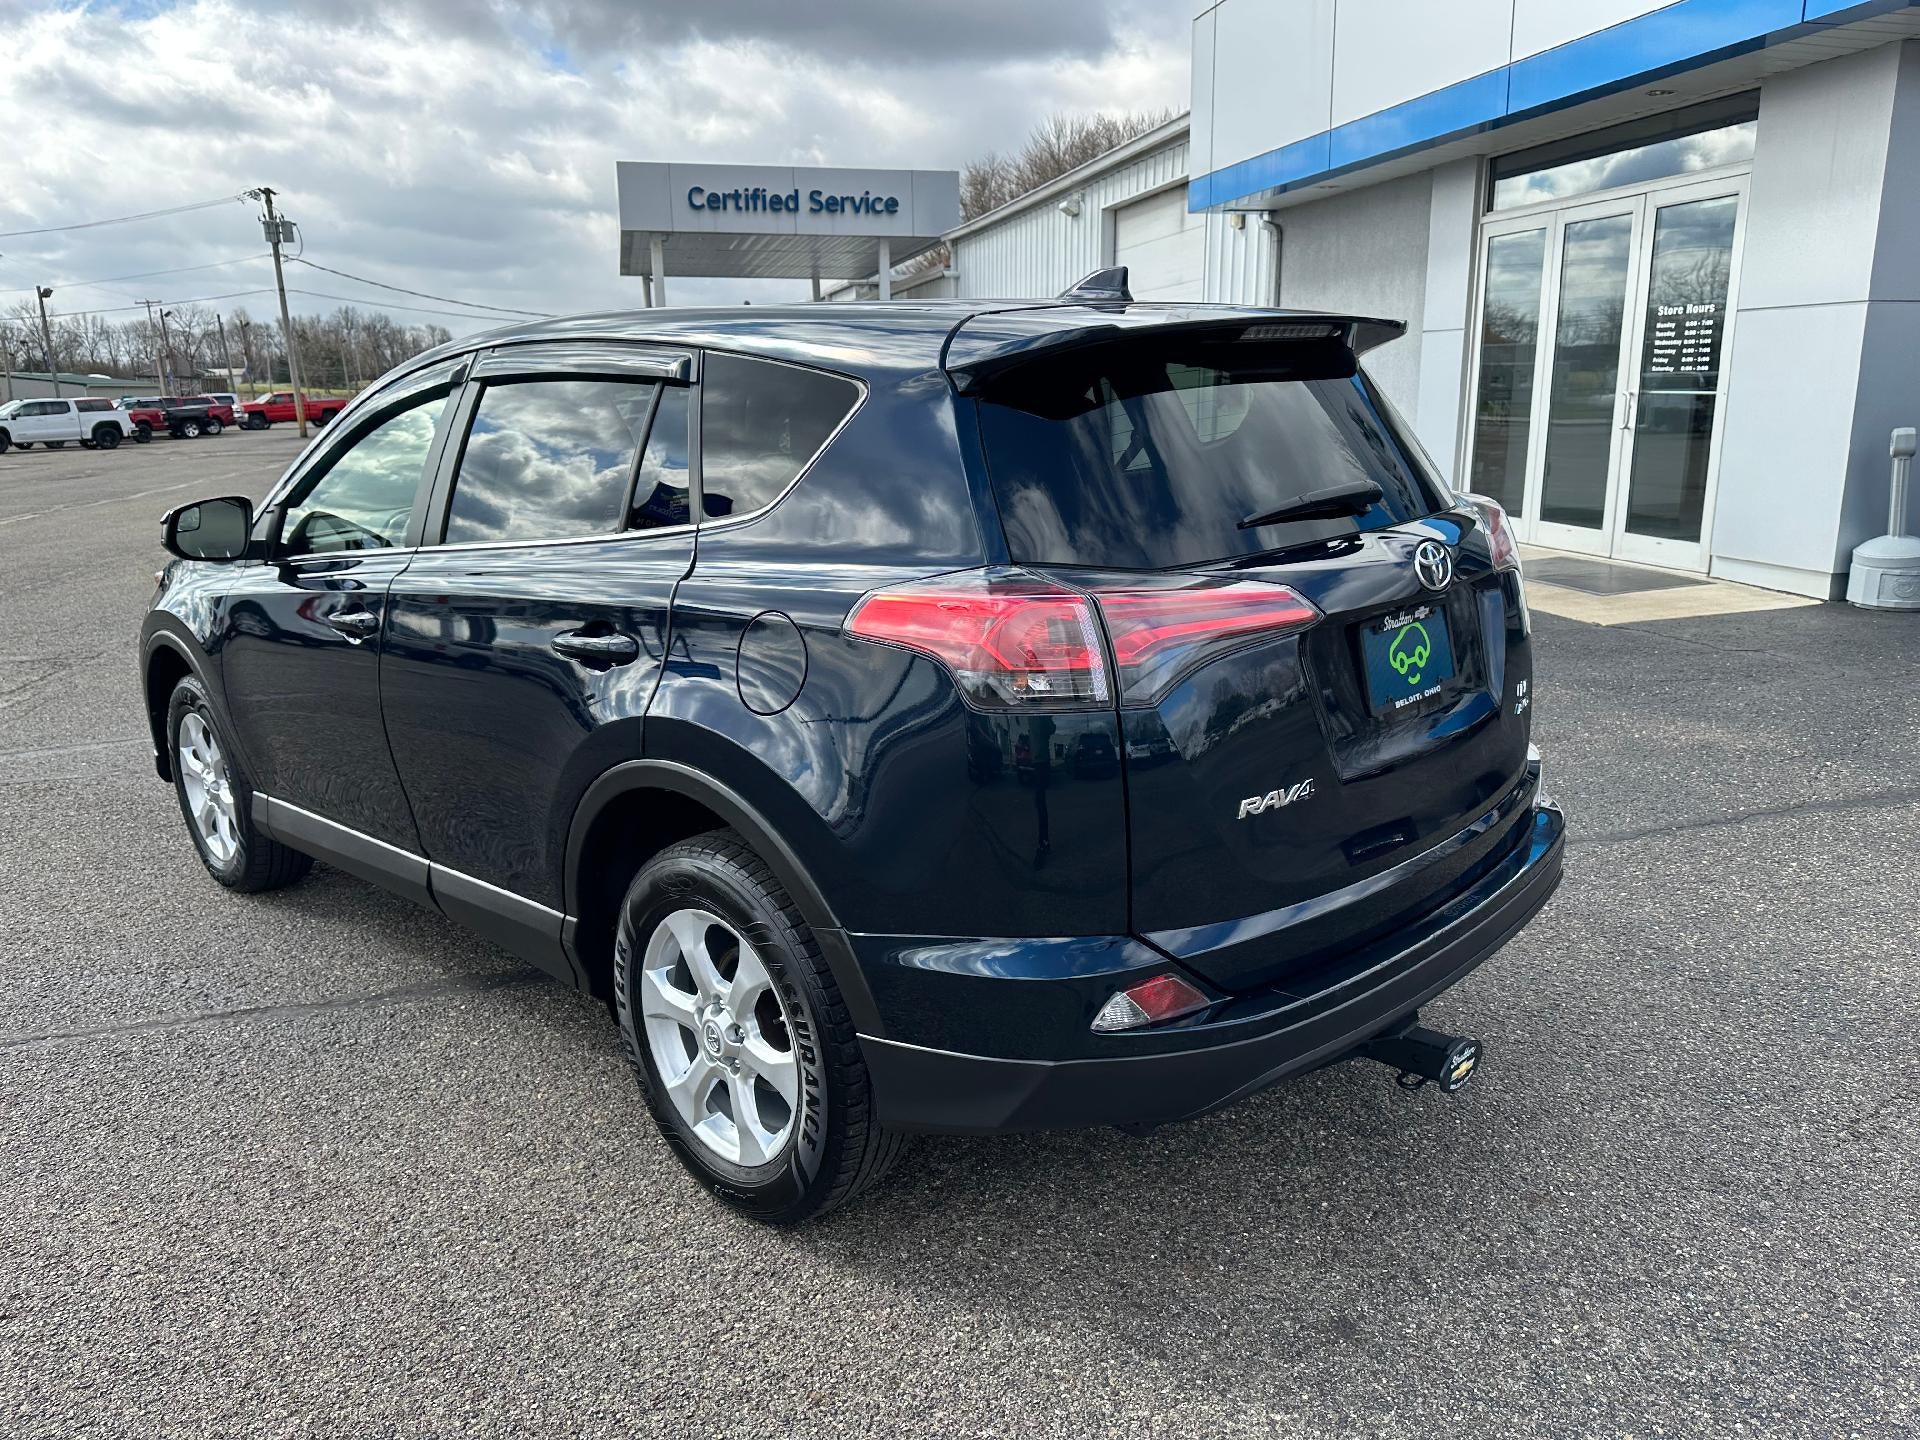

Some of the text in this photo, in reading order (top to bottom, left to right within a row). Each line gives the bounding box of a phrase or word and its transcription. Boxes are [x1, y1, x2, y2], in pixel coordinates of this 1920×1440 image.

[687, 186, 900, 214] Certified Service
[1658, 303, 1716, 316] Store Hours
[1424, 685, 1441, 697] OHIO
[1237, 778, 1315, 819] RAV4
[772, 967, 820, 1152] ASSURANCE
